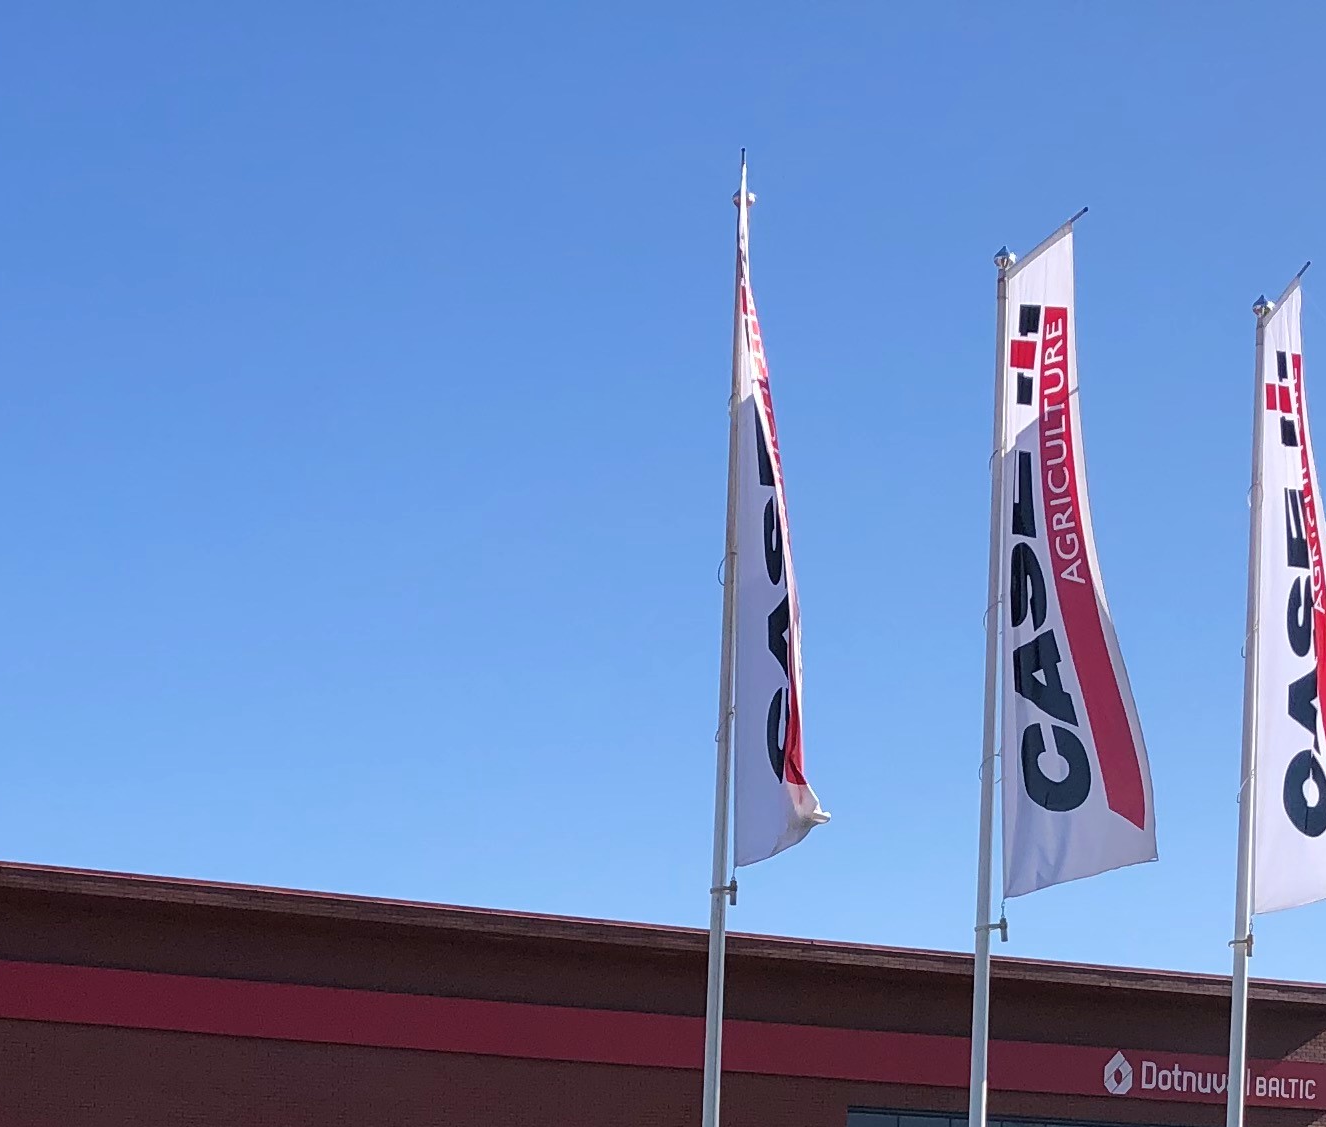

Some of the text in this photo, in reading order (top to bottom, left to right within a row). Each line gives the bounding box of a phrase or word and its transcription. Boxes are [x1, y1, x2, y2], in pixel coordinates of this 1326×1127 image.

[1038, 317, 1086, 584] AGRICULTURE
[1140, 1060, 1316, 1099] Dotnuv BALTIC
